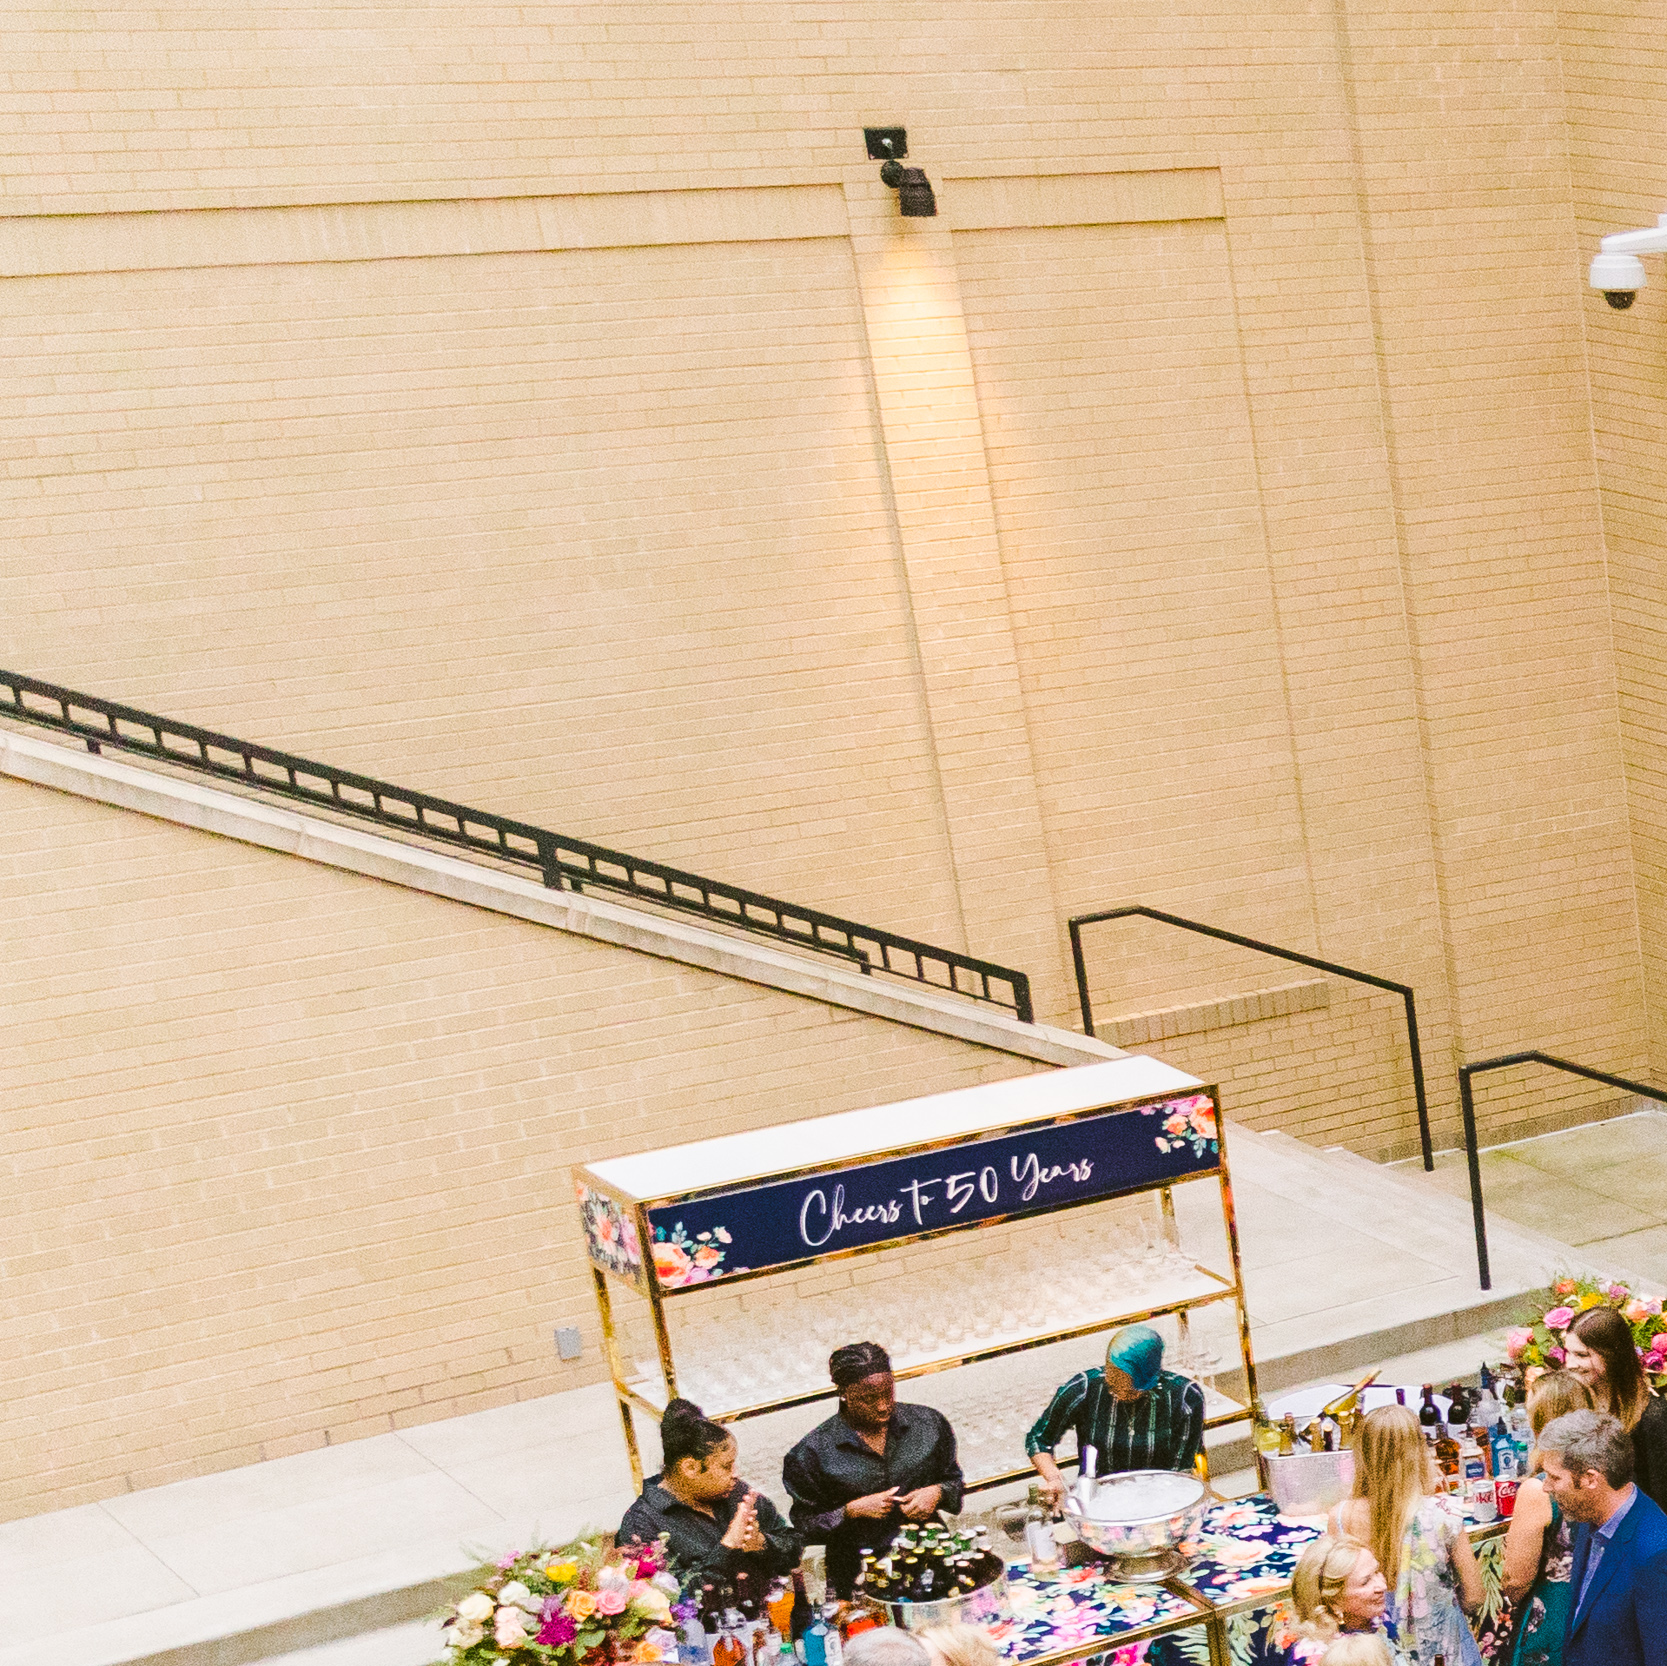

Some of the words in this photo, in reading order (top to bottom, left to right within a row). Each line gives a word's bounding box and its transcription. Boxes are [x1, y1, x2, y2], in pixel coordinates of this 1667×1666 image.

[800, 1184, 904, 1246] Cheers
[944, 1166, 999, 1214] 50
[1010, 1152, 1096, 1201] Years
